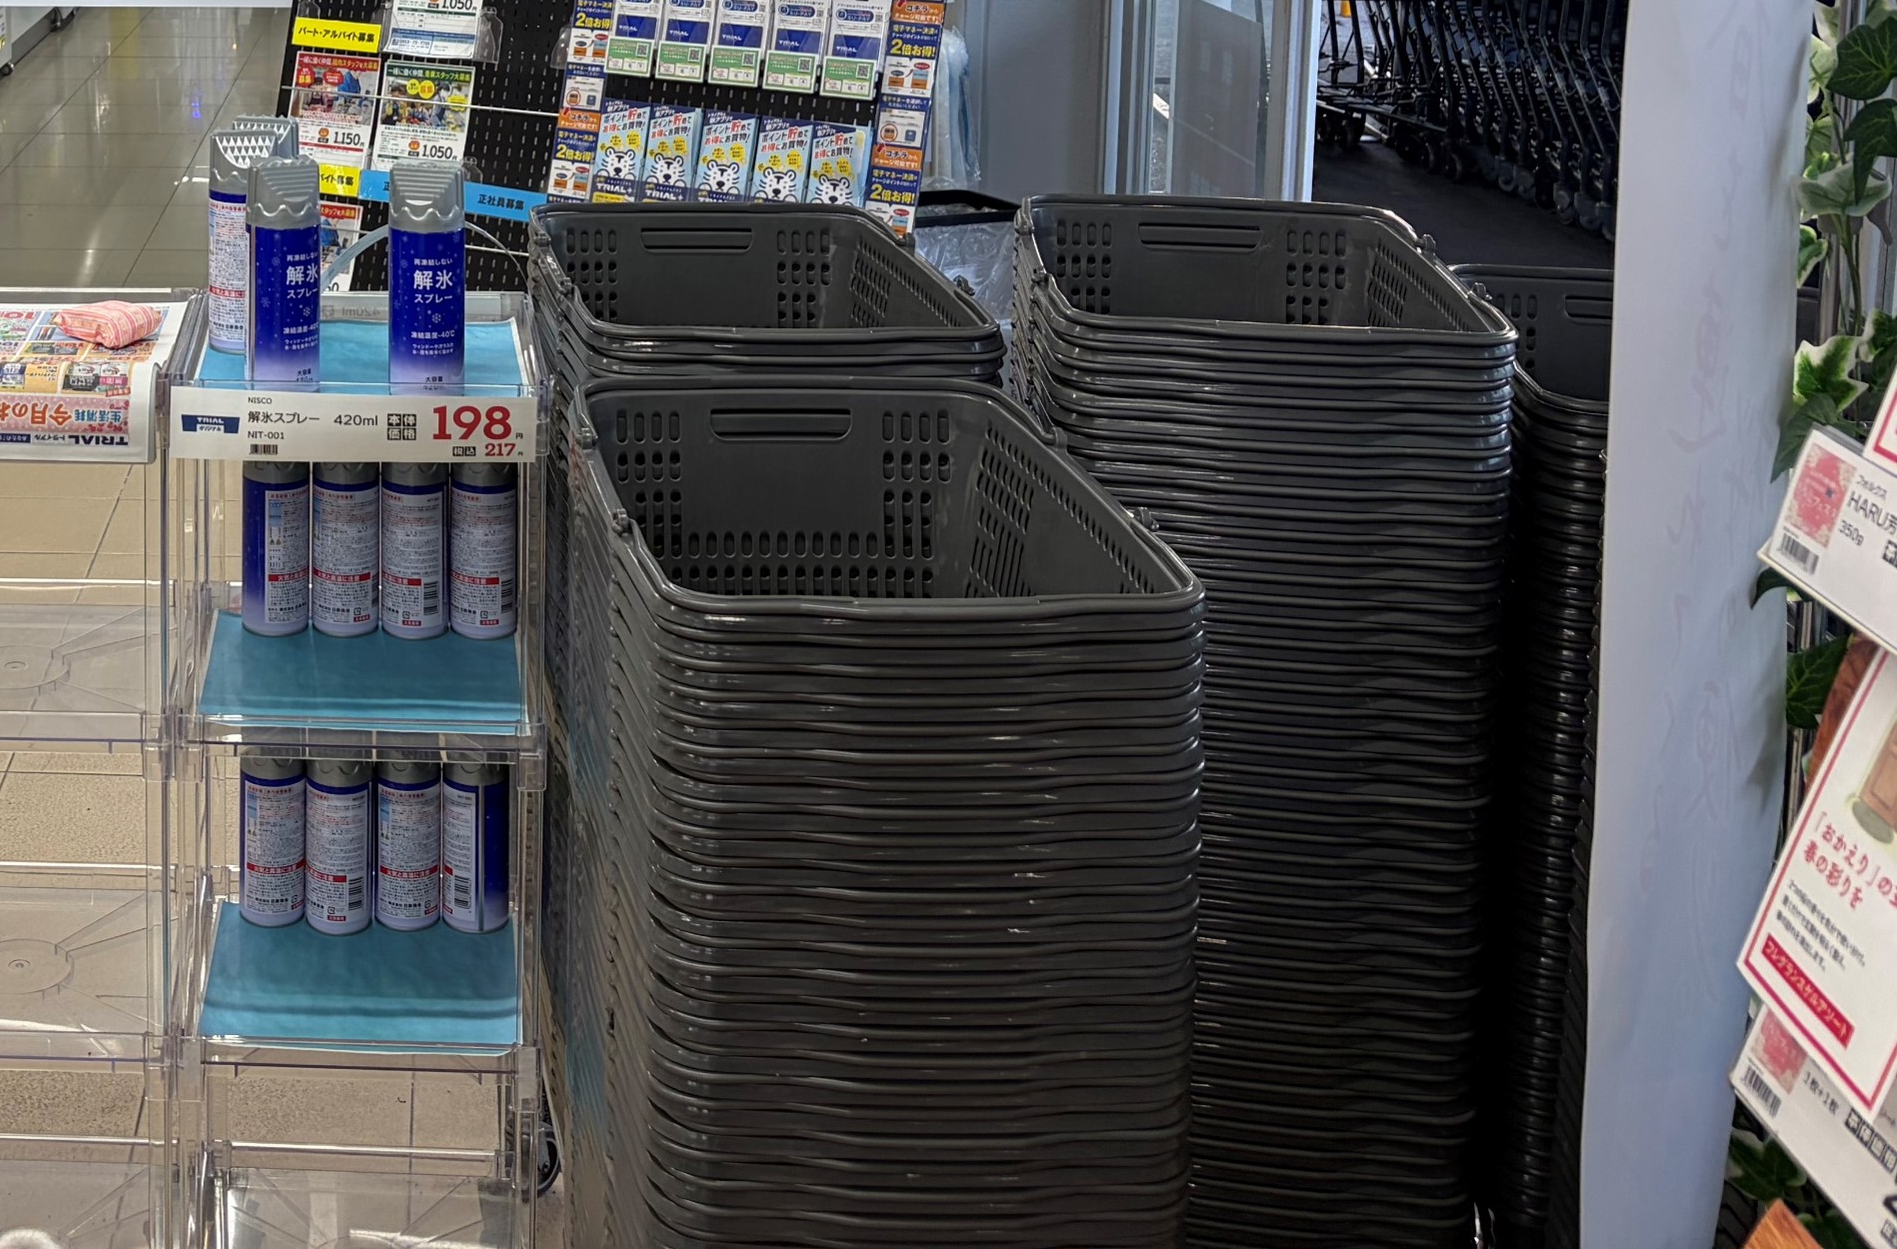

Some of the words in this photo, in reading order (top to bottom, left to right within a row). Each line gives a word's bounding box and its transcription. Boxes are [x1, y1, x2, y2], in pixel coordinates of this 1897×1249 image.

[576, 13, 612, 28] 2倍お得
[297, 26, 375, 44] パート・アルバイト募集
[890, 39, 936, 57] 2倍お得!
[477, 193, 525, 210] 正社員募集
[286, 263, 318, 285] 解氷
[413, 270, 453, 290] 解氷
[287, 288, 319, 299] スプレー
[414, 294, 453, 304] スプレー
[248, 397, 273, 405] NISCO
[74, 408, 123, 423] 生活消耗
[248, 411, 320, 425] 解氷スプレー
[333, 414, 378, 427] 420ml
[432, 405, 512, 441] 198
[35, 434, 66, 442] トライアル
[69, 433, 129, 446] TRIAL
[248, 431, 285, 440] NIT-001
[485, 443, 516, 457] 217
[1839, 519, 1865, 547] 350g
[1802, 842, 1864, 910] 春の彩りを
